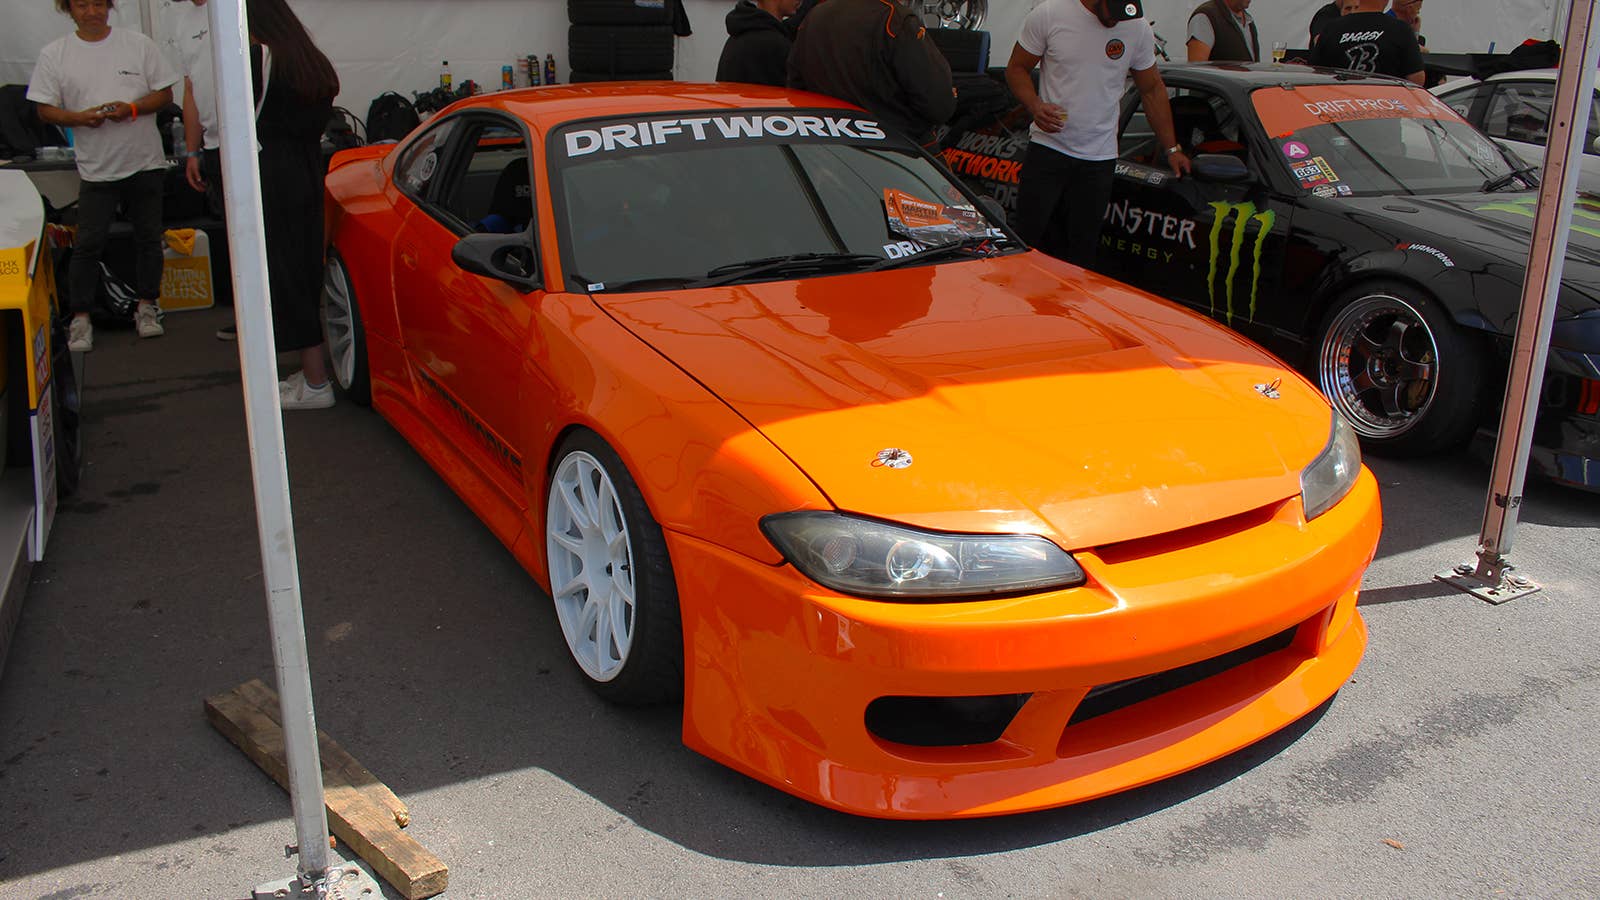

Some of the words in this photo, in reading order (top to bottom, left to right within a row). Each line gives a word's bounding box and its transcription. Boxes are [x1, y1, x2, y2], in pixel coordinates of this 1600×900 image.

[1340, 30, 1384, 43] BAGGSY
[1303, 99, 1357, 115] DRIFT
[564, 115, 886, 157] DRIFTWORKS
[1296, 166, 1319, 177] 663
[1408, 243, 1455, 267] NANKANG
